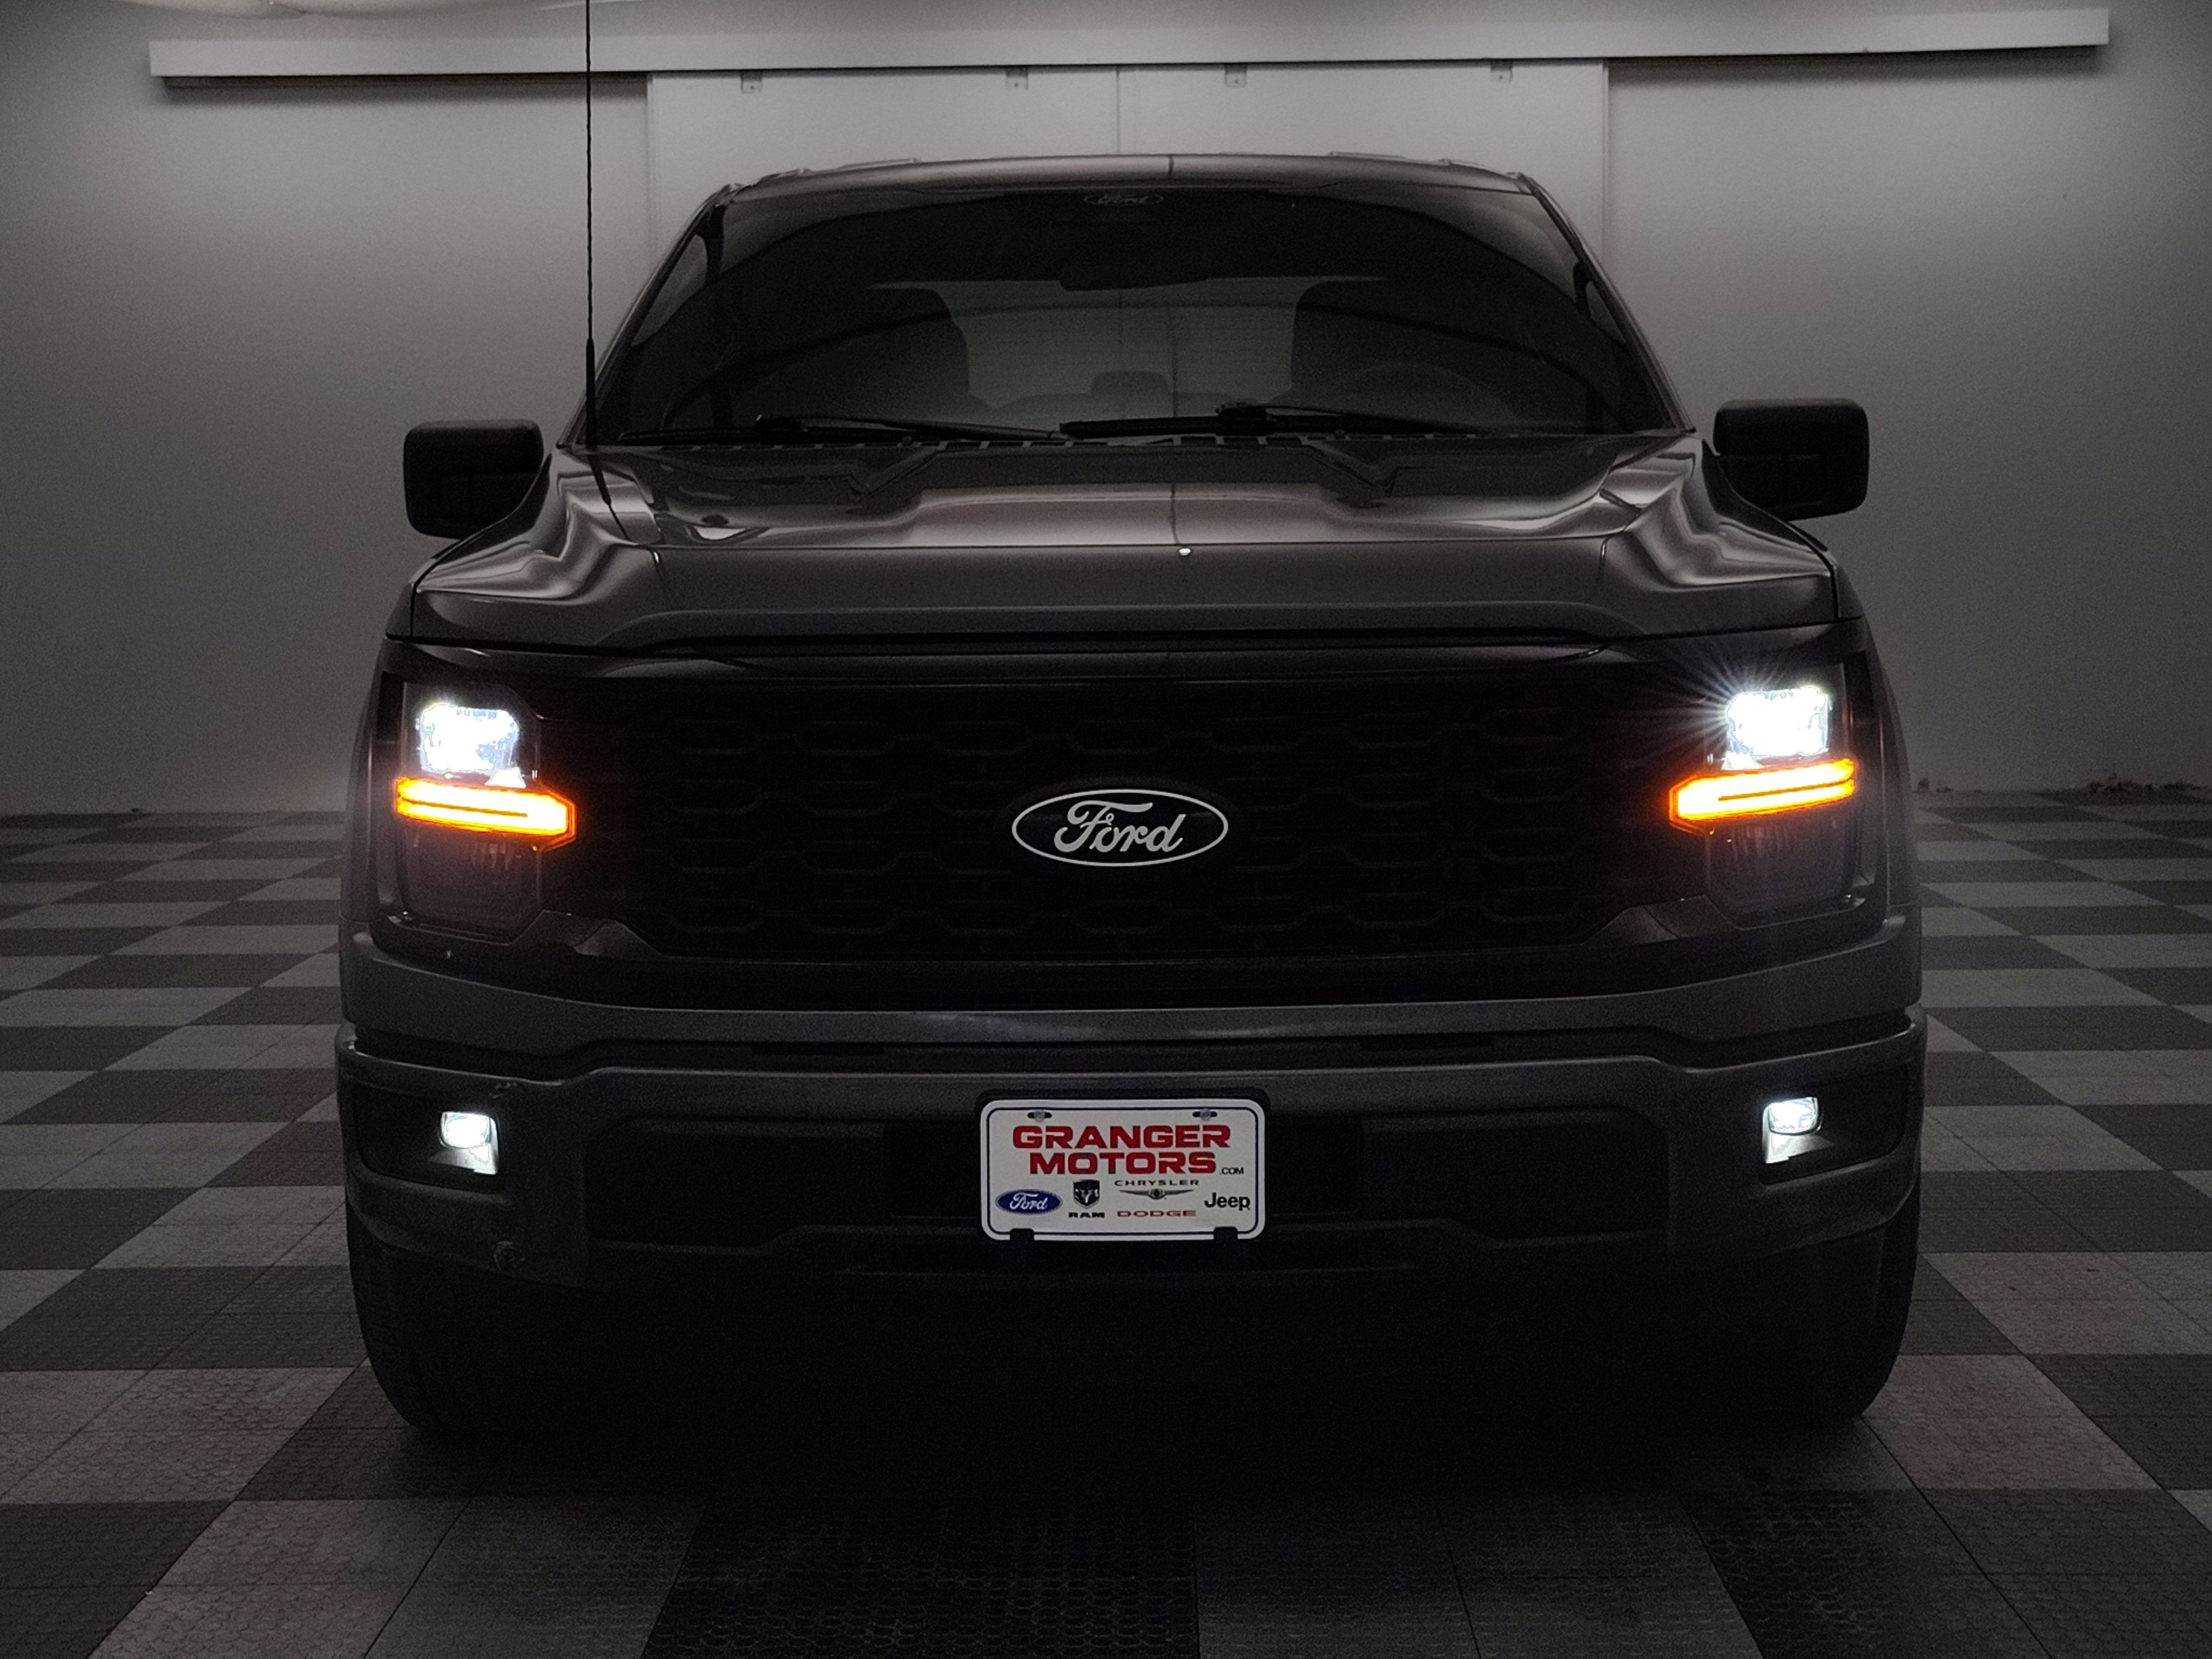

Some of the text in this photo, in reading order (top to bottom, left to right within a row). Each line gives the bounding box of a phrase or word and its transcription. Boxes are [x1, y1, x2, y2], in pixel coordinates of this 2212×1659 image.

[1054, 800, 1186, 852] Ford
[1013, 1125, 1231, 1149] GRANGER
[1030, 1151, 1244, 1175] MOTORS .COM
[1009, 1193, 1048, 1210] Ford
[1204, 1192, 1250, 1211] Jeep
